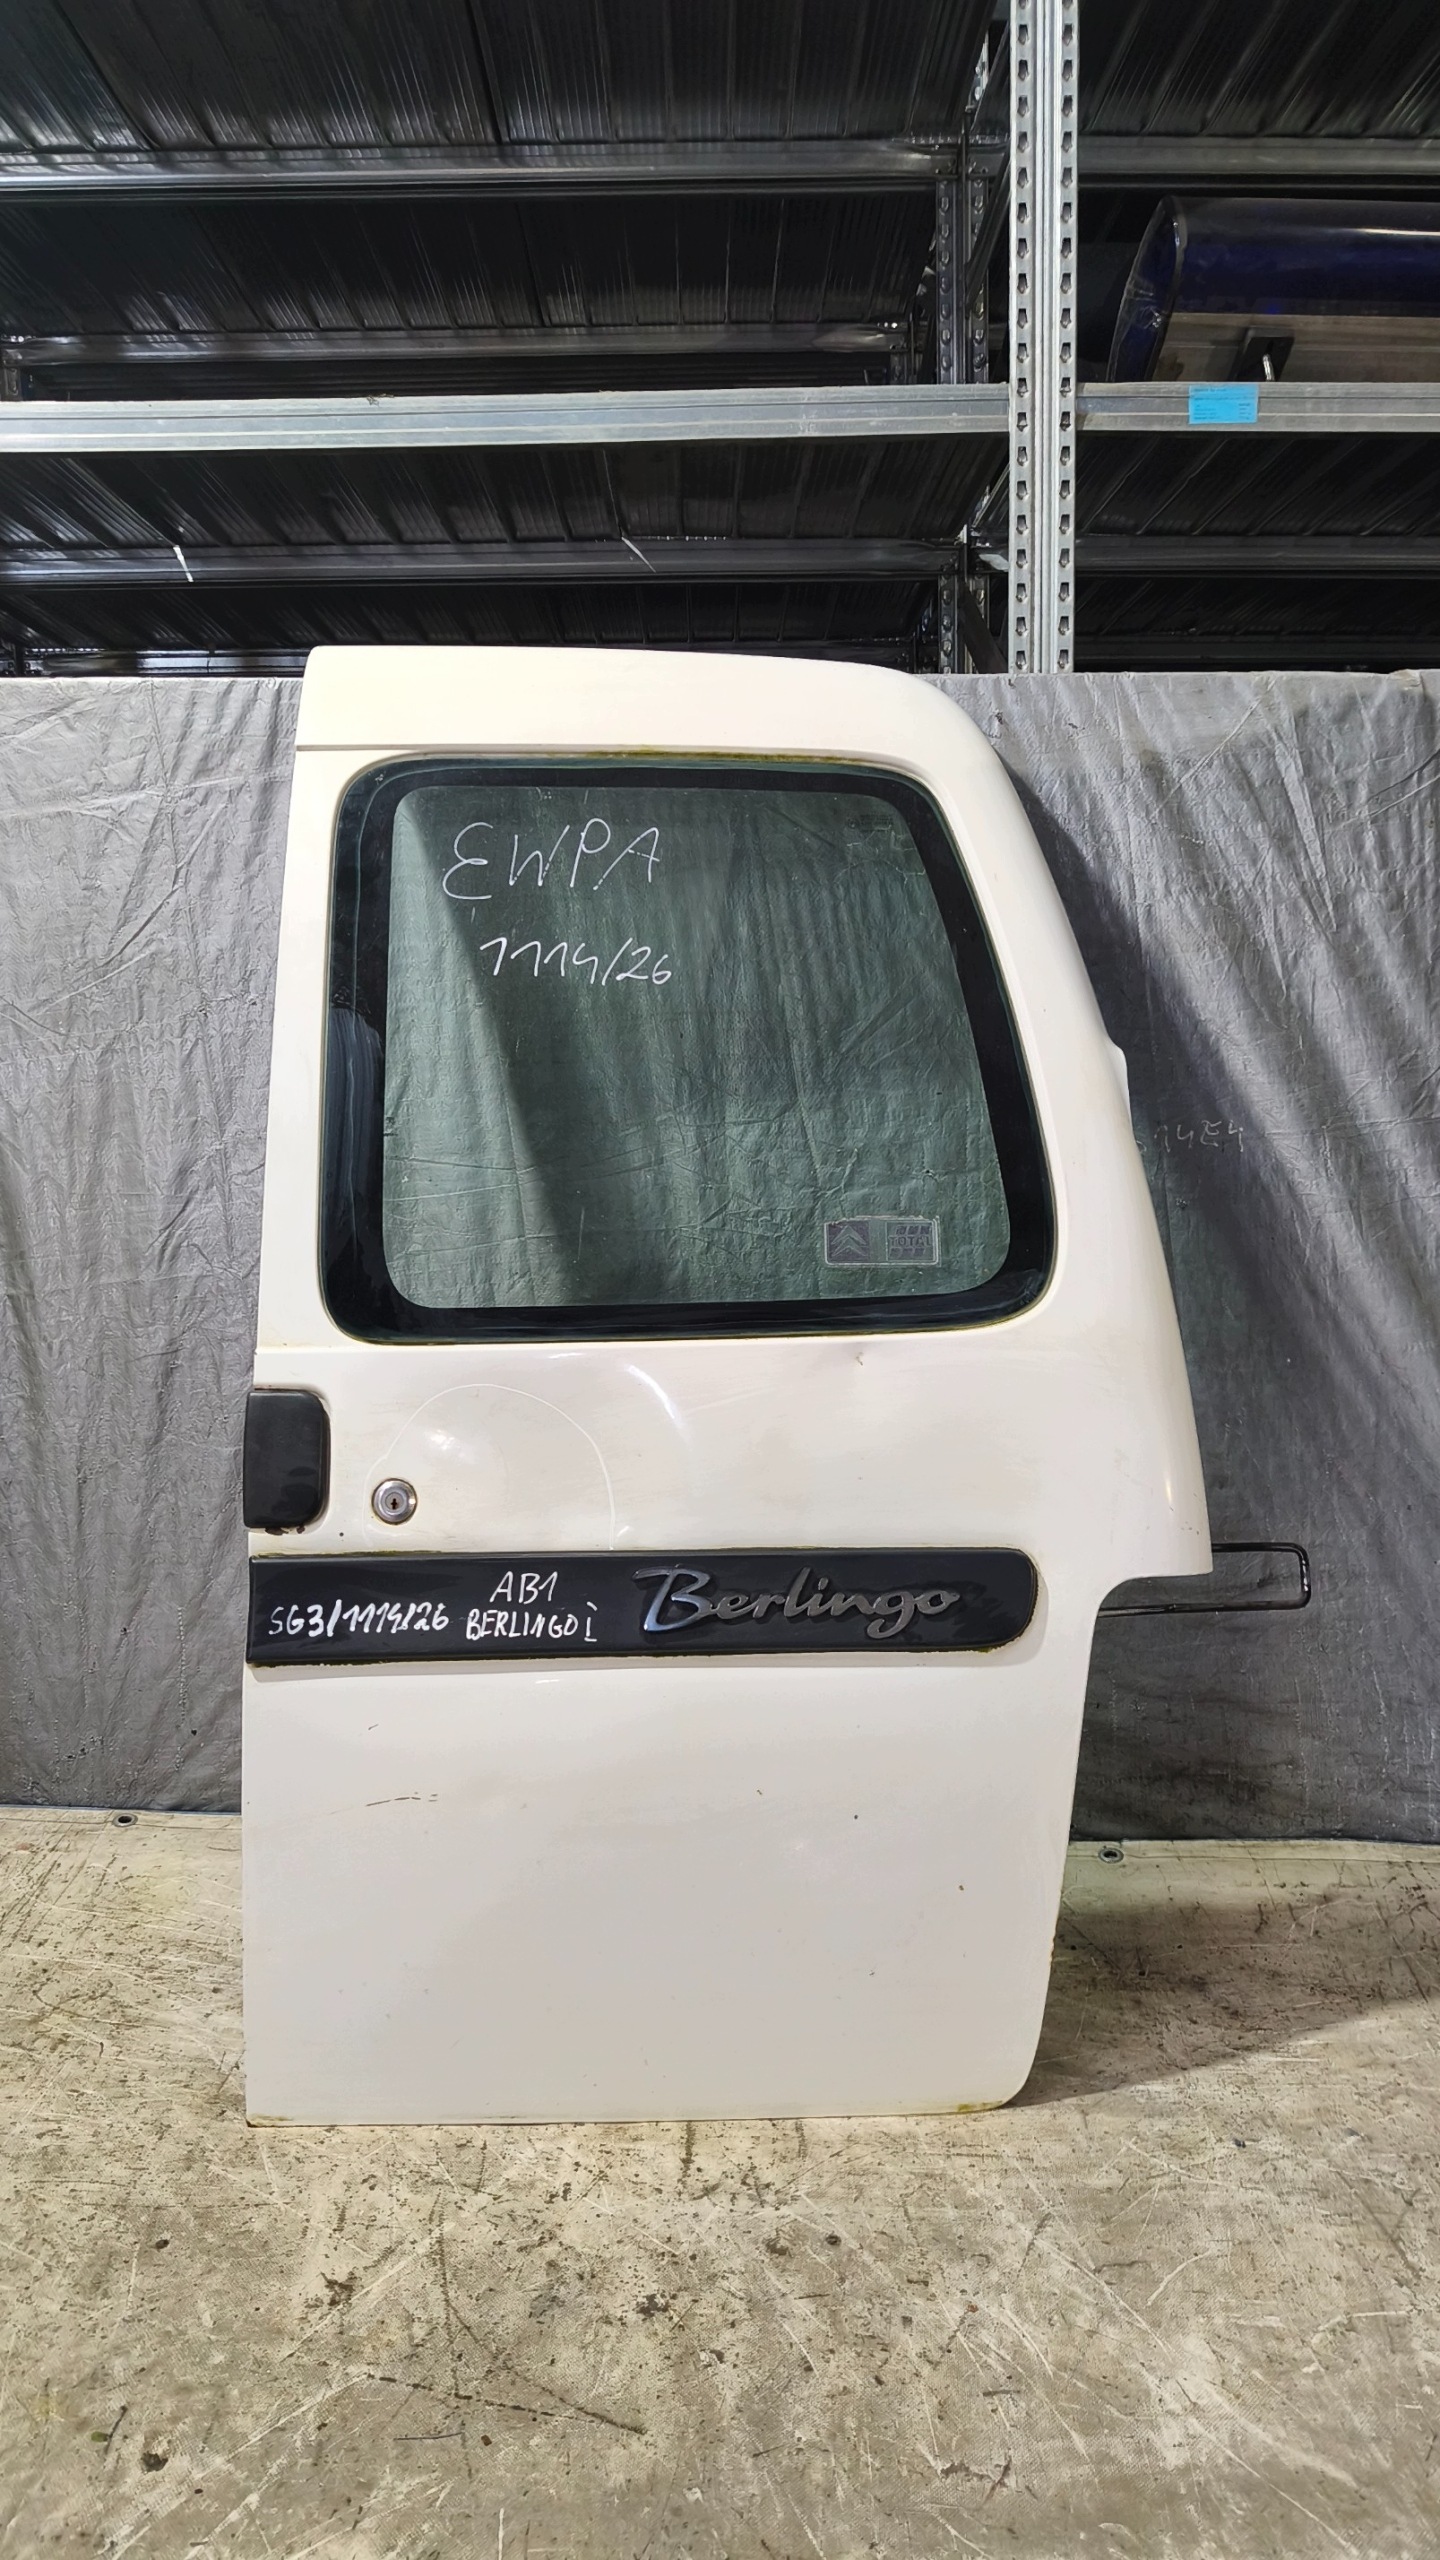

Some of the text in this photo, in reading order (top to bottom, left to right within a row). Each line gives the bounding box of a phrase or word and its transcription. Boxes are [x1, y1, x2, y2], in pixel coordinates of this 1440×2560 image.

[443, 818, 660, 900] EWPA
[479, 937, 672, 985] 1114/26
[889, 1236, 932, 1247] TOTAL
[490, 1571, 558, 1602] AB1
[631, 1563, 961, 1639] Berlingo
[465, 1608, 579, 1641] BERLINGO
